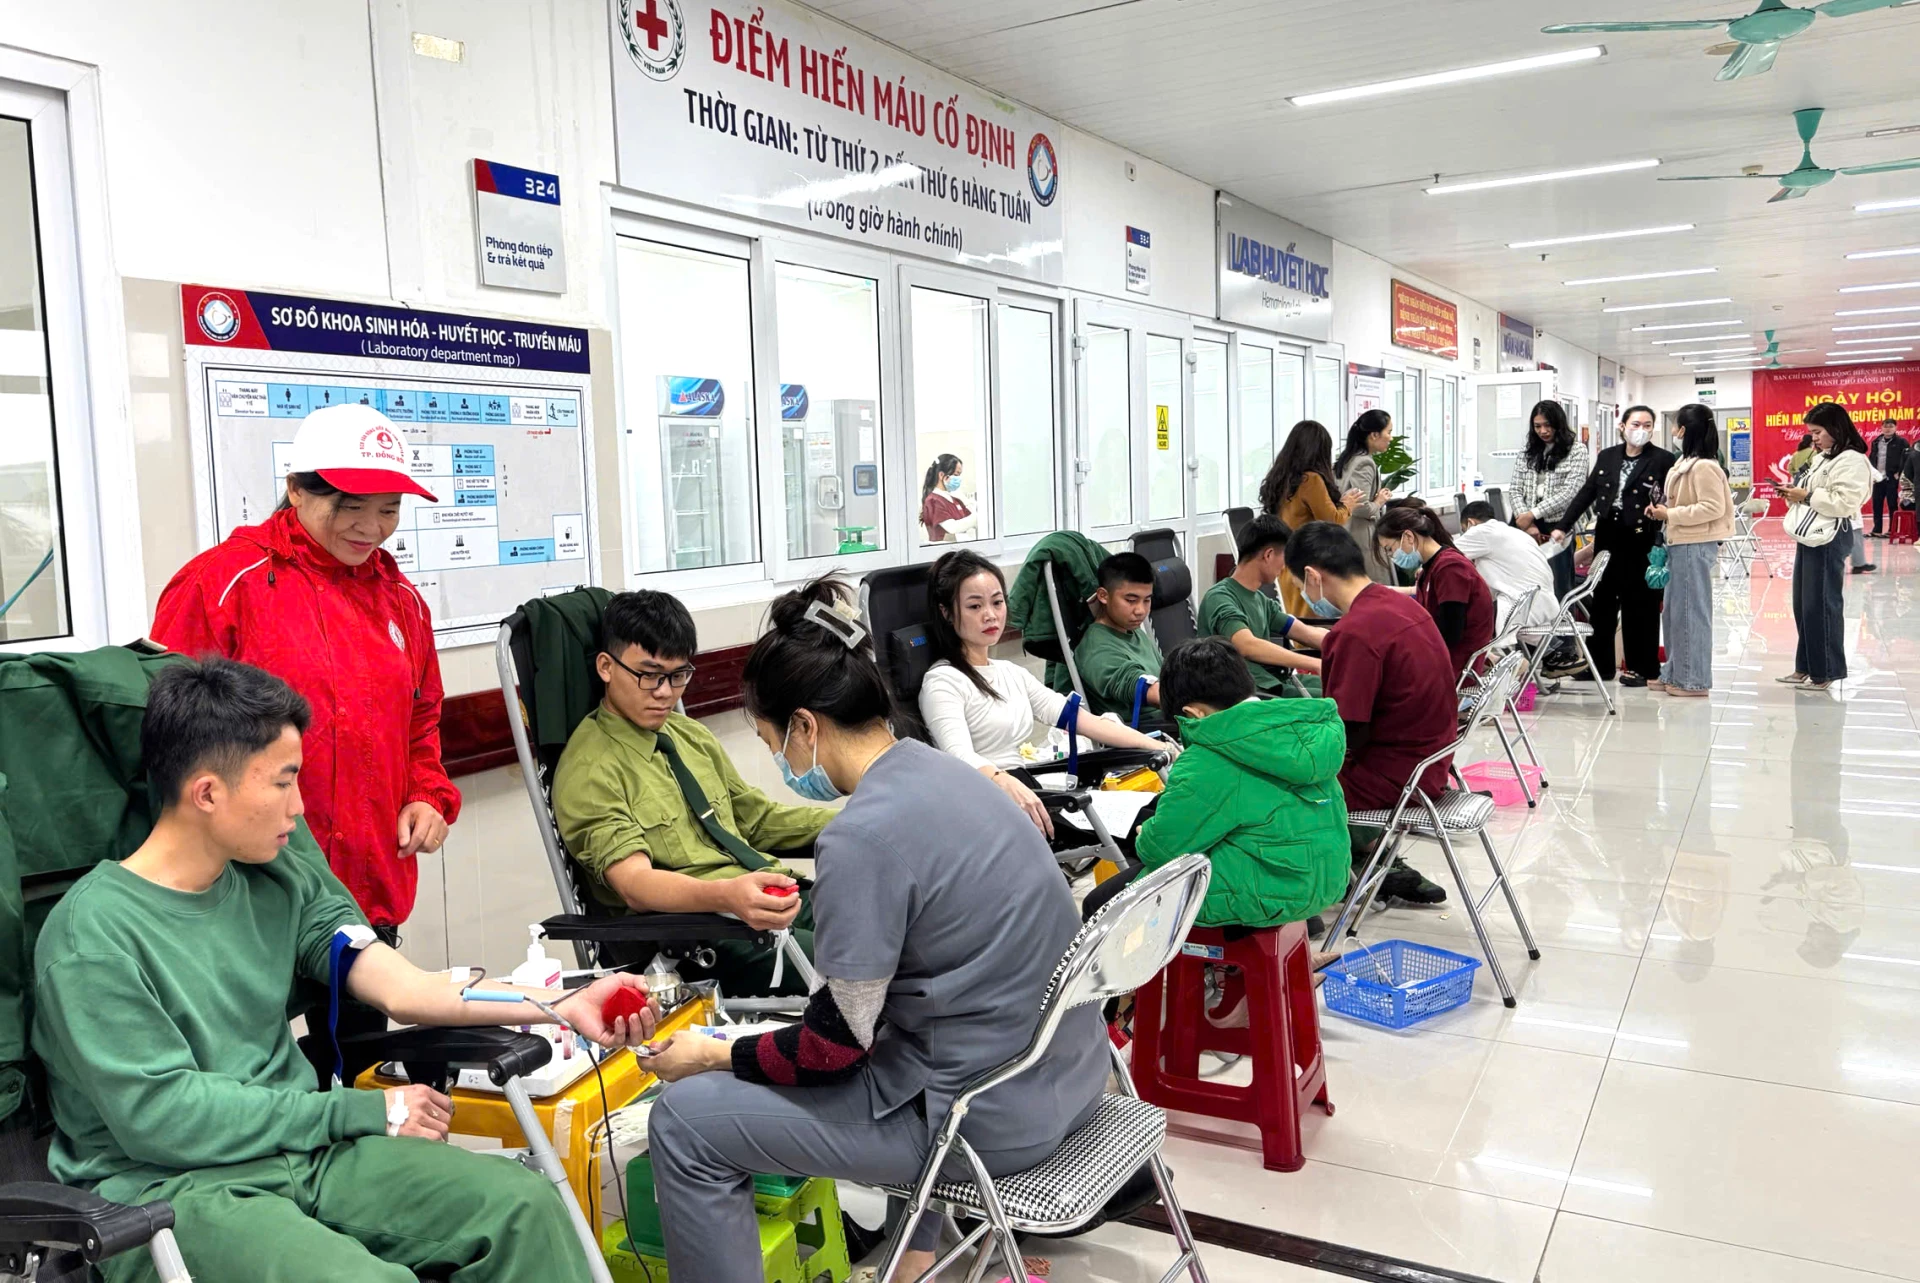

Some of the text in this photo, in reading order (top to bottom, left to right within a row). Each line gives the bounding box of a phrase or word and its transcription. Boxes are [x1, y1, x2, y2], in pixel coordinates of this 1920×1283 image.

[710, 6, 791, 89] ĐIỂM
[800, 46, 865, 116] HIẾN
[873, 75, 926, 137] MÁU
[933, 94, 960, 149] CỐ
[966, 113, 1015, 170] ĐỊNH
[683, 87, 738, 137] THỜI
[743, 108, 799, 155] GIAN:
[803, 124, 828, 163] TỪ
[831, 137, 866, 173] THỨ
[917, 166, 947, 199] THỨ
[950, 176, 959, 203] 6
[962, 177, 997, 214] HÀNG
[999, 190, 1031, 225] TUẦN
[525, 177, 557, 199] 324
[859, 205, 884, 233] giờ
[887, 209, 920, 240] hành
[924, 221, 963, 256] chính)
[485, 236, 553, 259] Phòng đón tiếp
[487, 252, 545, 272] & trả kết quả
[1227, 231, 1329, 303] LAB HUYẾT HỌC
[271, 307, 294, 326] SƠ
[295, 305, 318, 328] ĐỒ
[322, 311, 363, 333] KHOA
[366, 315, 398, 336] SINH
[401, 318, 429, 339] HÓA
[439, 322, 479, 344] HUYẾT
[481, 329, 506, 350] HỌC
[513, 331, 556, 350] TRUYỀN
[558, 335, 582, 353] MÁU
[368, 341, 429, 361] Laboratory
[431, 346, 491, 363] department
[494, 354, 515, 367] map
[1805, 388, 1902, 407] NGÀY HỘI
[1765, 411, 1790, 427] HIẾN
[1888, 407, 1914, 421] NĂM
